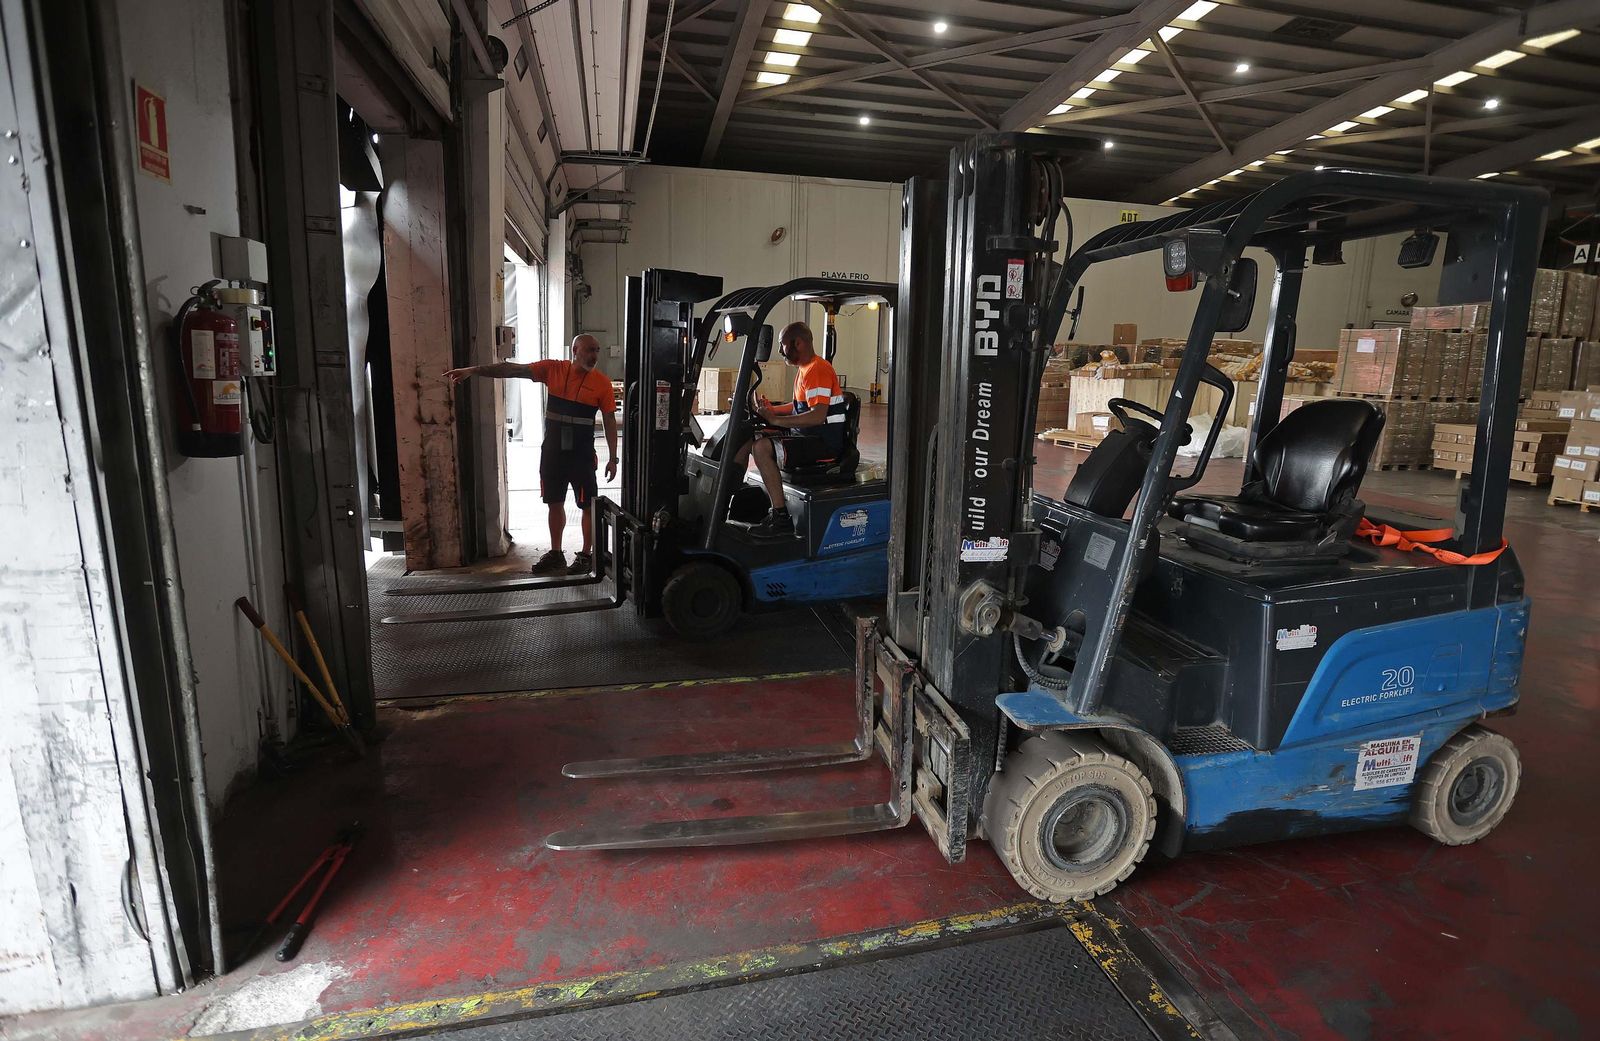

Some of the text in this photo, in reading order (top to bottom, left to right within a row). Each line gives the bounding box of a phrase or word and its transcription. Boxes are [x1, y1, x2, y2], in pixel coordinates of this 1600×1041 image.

[1575, 248, 1587, 260] A
[821, 271, 870, 280] PLAYA FRIO
[974, 274, 1002, 356] BYD
[1381, 665, 1415, 691] 20
[1341, 686, 1415, 708] ELECTRIC FORKLIFT
[1364, 743, 1415, 757] ALQUILER
[1370, 740, 1400, 749] MAQUINA
